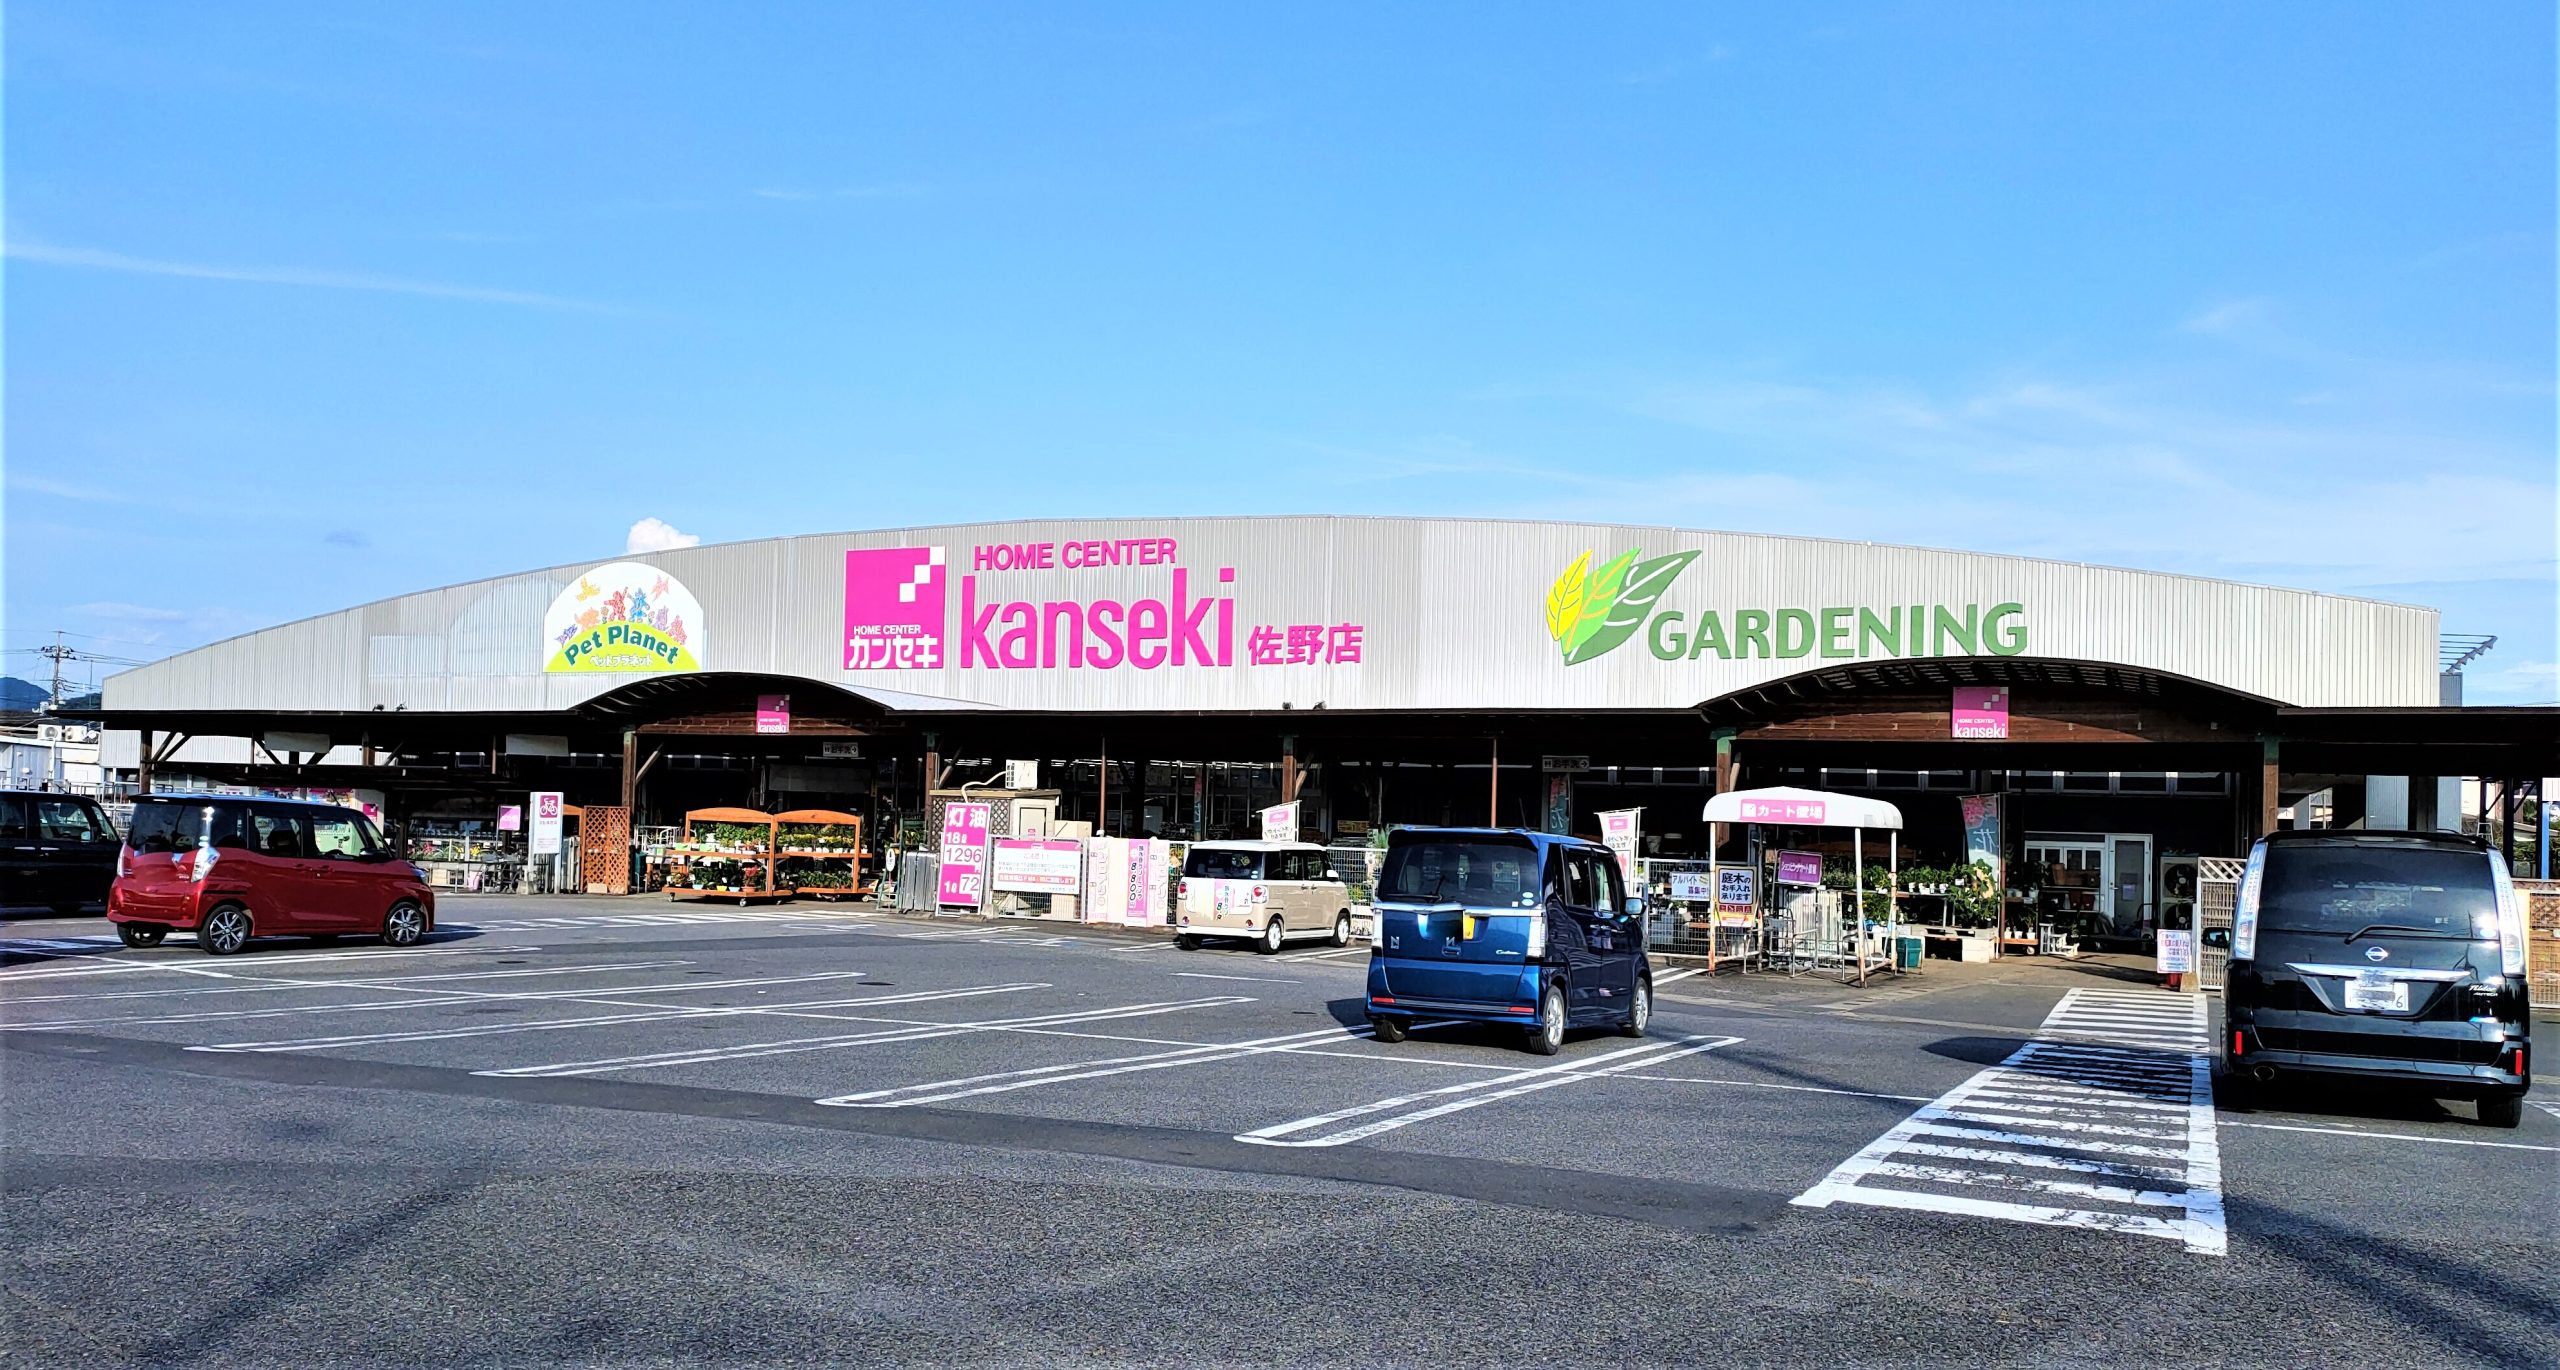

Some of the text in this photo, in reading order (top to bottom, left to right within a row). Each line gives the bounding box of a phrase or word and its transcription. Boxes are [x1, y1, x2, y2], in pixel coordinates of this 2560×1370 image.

[973, 537, 1177, 571] HOME CENTER
[960, 566, 1235, 669] kanseki
[853, 624, 922, 635] HOME CENTER
[1647, 602, 2028, 660] GARDENING
[564, 624, 679, 666] Pet Planet
[848, 633, 938, 668] カンセキ
[1248, 622, 1364, 666] 佐野店
[1954, 722, 2006, 739] kanseki
[948, 807, 987, 829] 灯油
[945, 847, 982, 863] 1296
[961, 876, 979, 892] 72
[1672, 875, 1697, 885] アルバイト
[1721, 872, 1751, 884] 庭木の
[1721, 884, 1751, 892] お手入れ
[1721, 893, 1751, 901] 承ります
